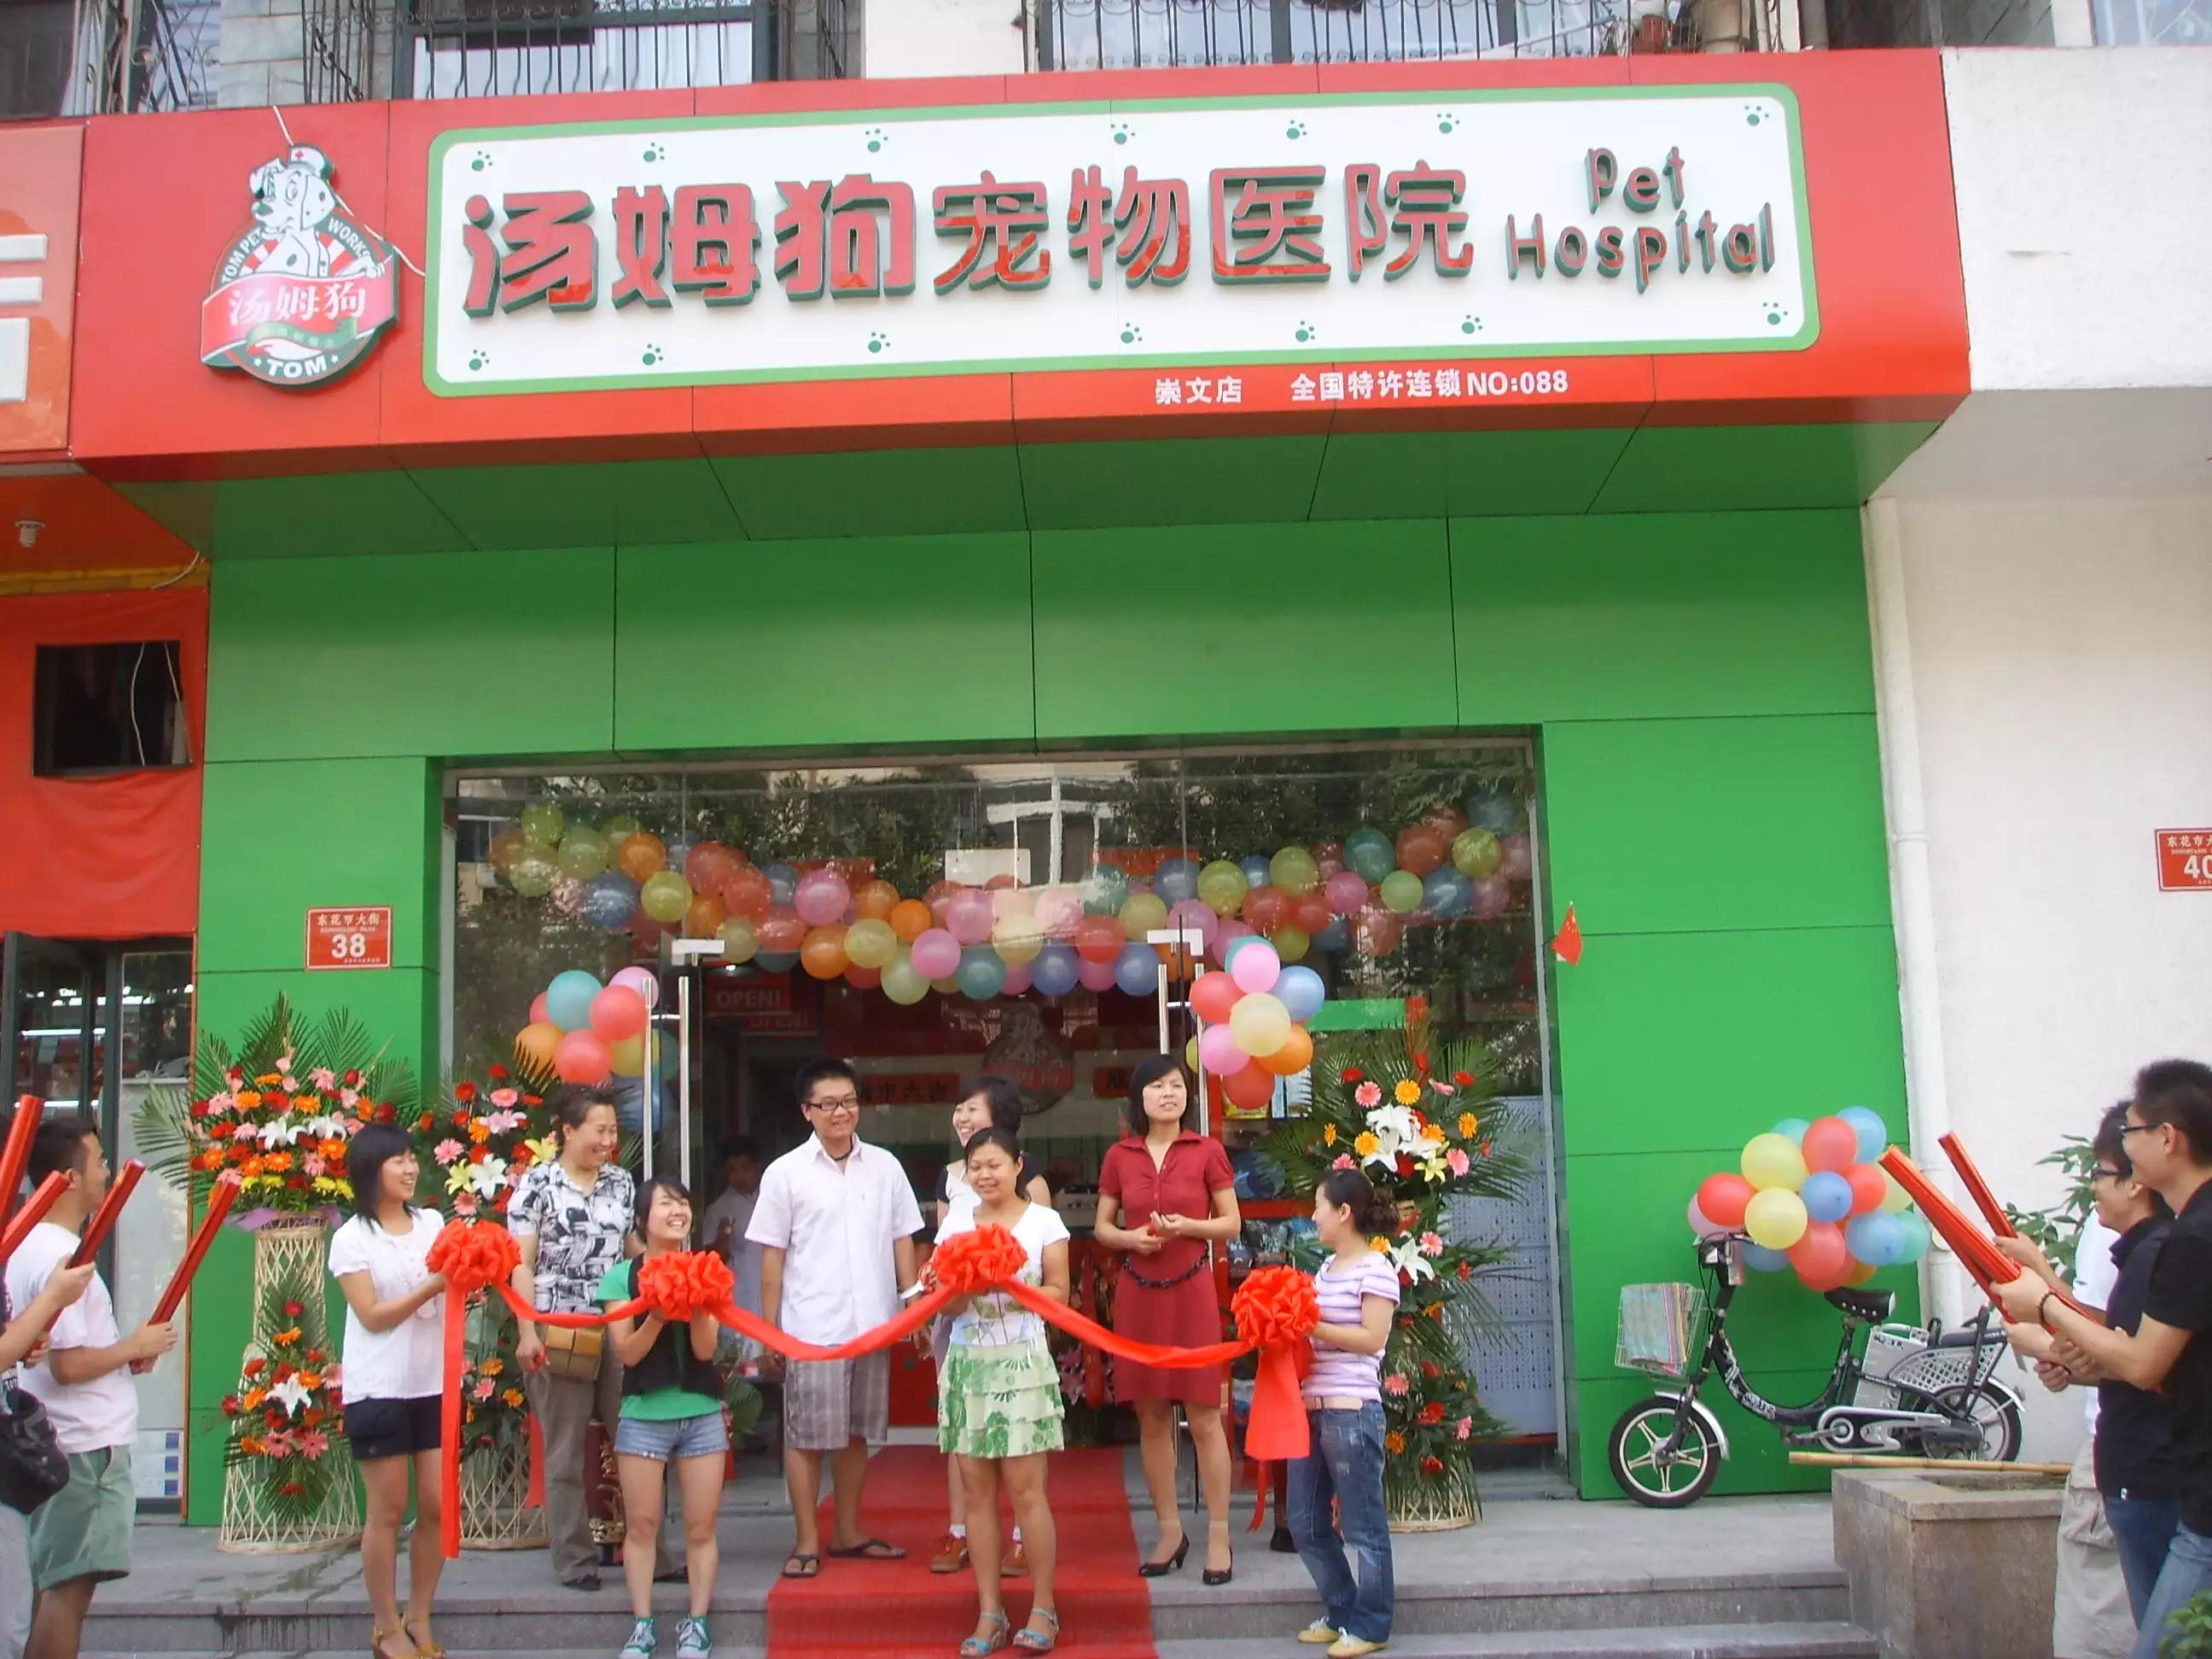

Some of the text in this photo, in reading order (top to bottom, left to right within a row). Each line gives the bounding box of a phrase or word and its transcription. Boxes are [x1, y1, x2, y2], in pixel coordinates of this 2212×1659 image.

[1584, 146, 1685, 214] Pet
[462, 160, 1475, 318] 汤姆狗宠物医院
[1505, 201, 1776, 294] Hospital
[229, 282, 366, 325] 汤姆狗
[267, 355, 328, 378] TOM
[1155, 375, 1243, 405] 崇文店
[1290, 369, 1461, 401] 全国特许连锁
[331, 933, 366, 958] 38
